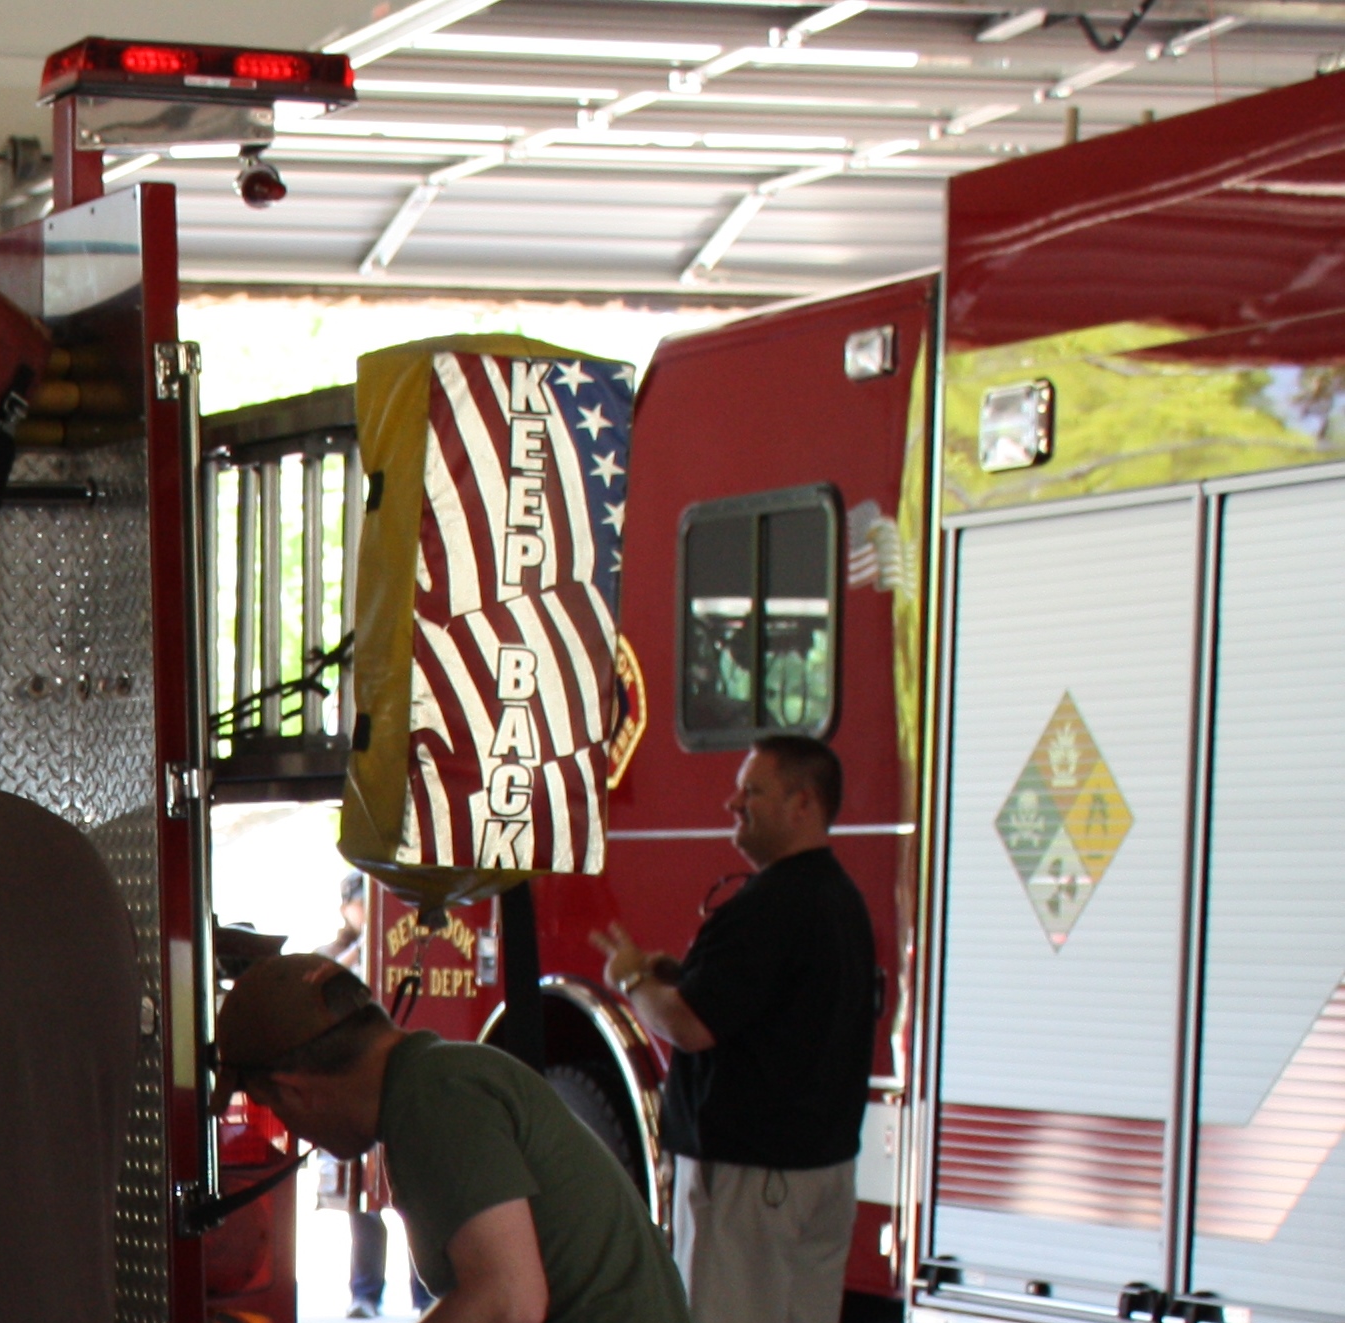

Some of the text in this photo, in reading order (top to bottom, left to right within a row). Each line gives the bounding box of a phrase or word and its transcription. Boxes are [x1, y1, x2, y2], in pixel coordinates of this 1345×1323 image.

[503, 359, 554, 588] KEEP
[478, 645, 537, 871] BACK
[386, 908, 476, 961] BENOOK
